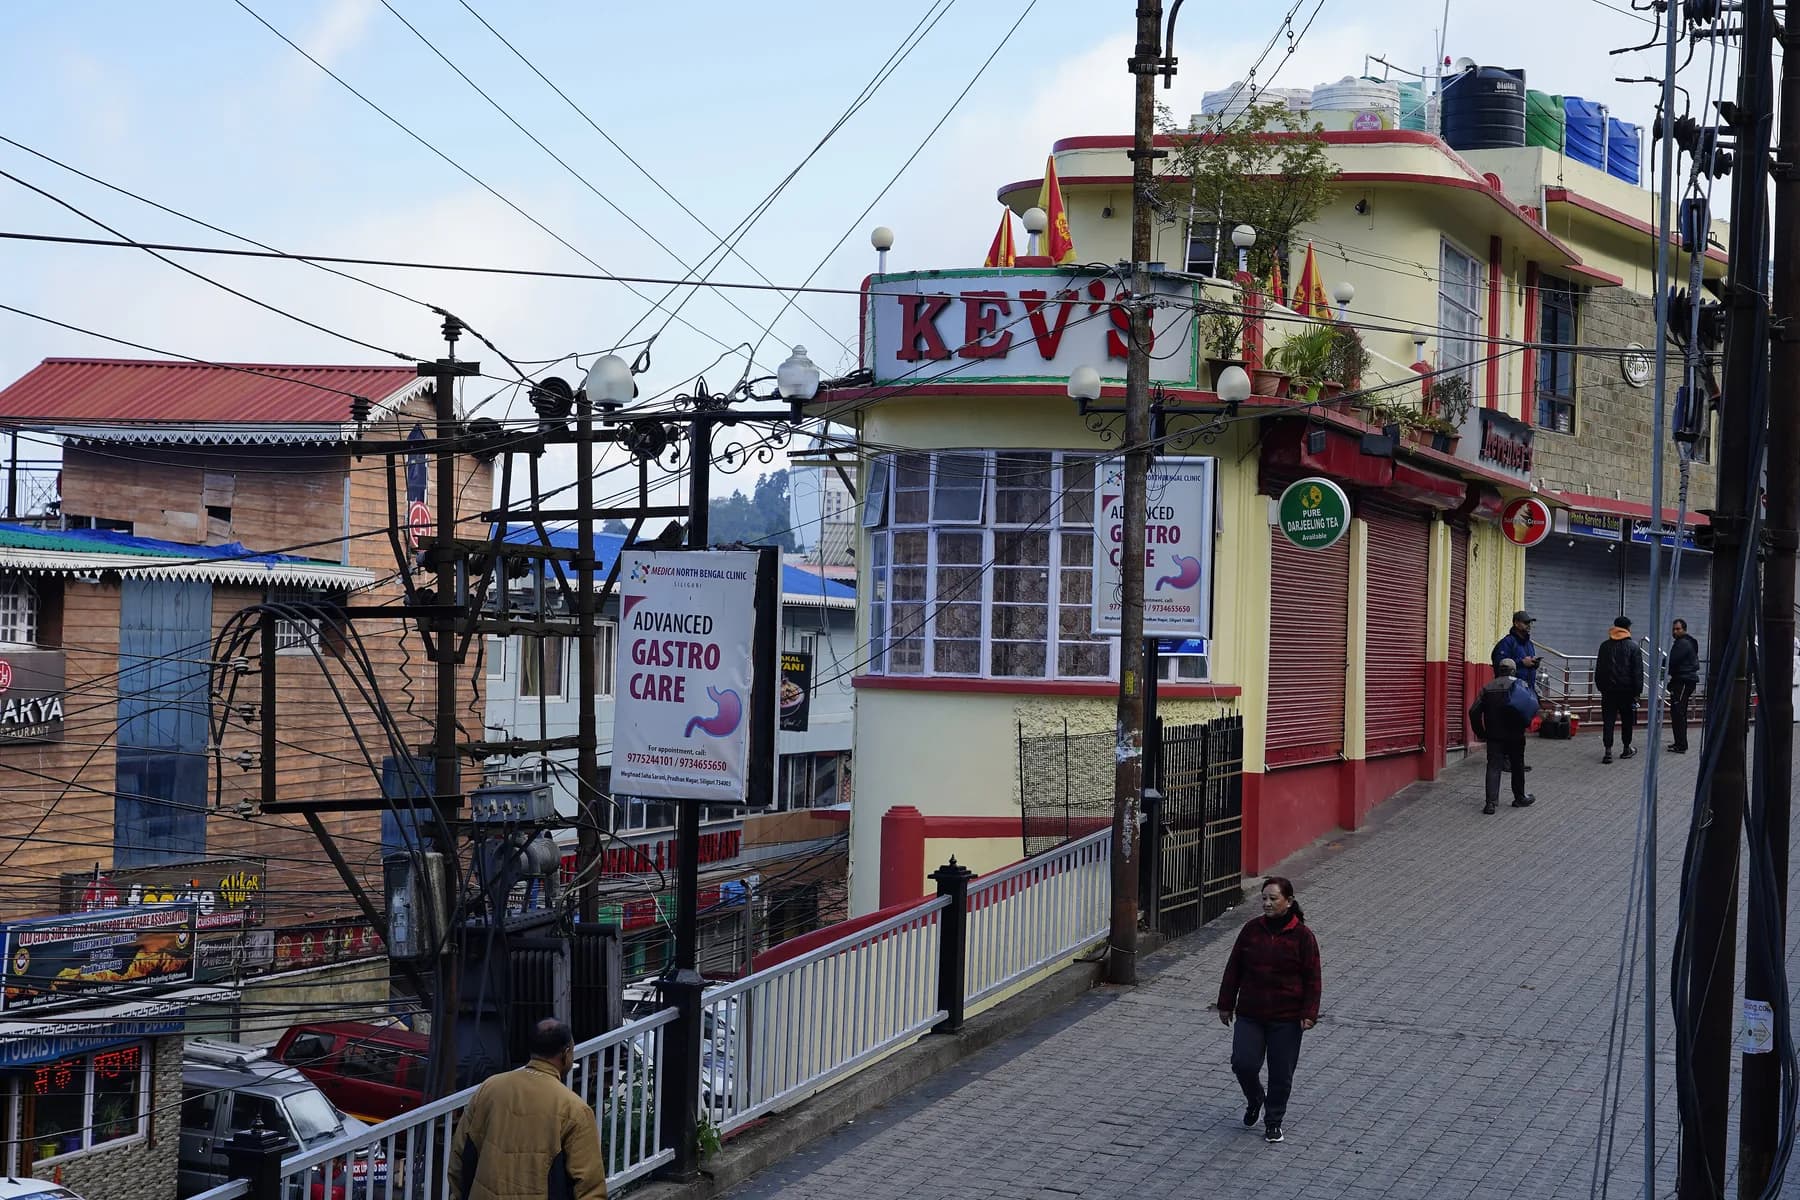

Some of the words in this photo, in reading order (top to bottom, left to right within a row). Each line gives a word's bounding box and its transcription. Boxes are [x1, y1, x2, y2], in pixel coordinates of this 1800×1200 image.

[896, 279, 1155, 361] KEV'S
[1303, 509, 1321, 517] PURE
[1110, 524, 1181, 544] GTRO
[1287, 518, 1325, 532] DARJEELING
[1326, 517, 1339, 528] TEA
[1302, 533, 1327, 541] Available
[1109, 548, 1155, 567] CE
[651, 566, 675, 576] MEDICA
[676, 567, 699, 578] NORTH
[700, 569, 725, 579] BENGAL
[726, 571, 747, 580] CLINIC
[1152, 605, 1191, 613] 9734655650
[633, 611, 713, 635] ADVANCED
[631, 639, 720, 670] GASTRO
[629, 673, 686, 703] CARE
[658, 746, 694, 756] appointment,
[695, 748, 707, 756] call:
[627, 752, 673, 766] 9775244101
[679, 757, 727, 772] 9734655650
[19, 931, 32, 947] OLD
[33, 928, 49, 945] CLUB
[125, 912, 150, 930] WELFARE
[150, 909, 189, 927] ASSOCIATION
